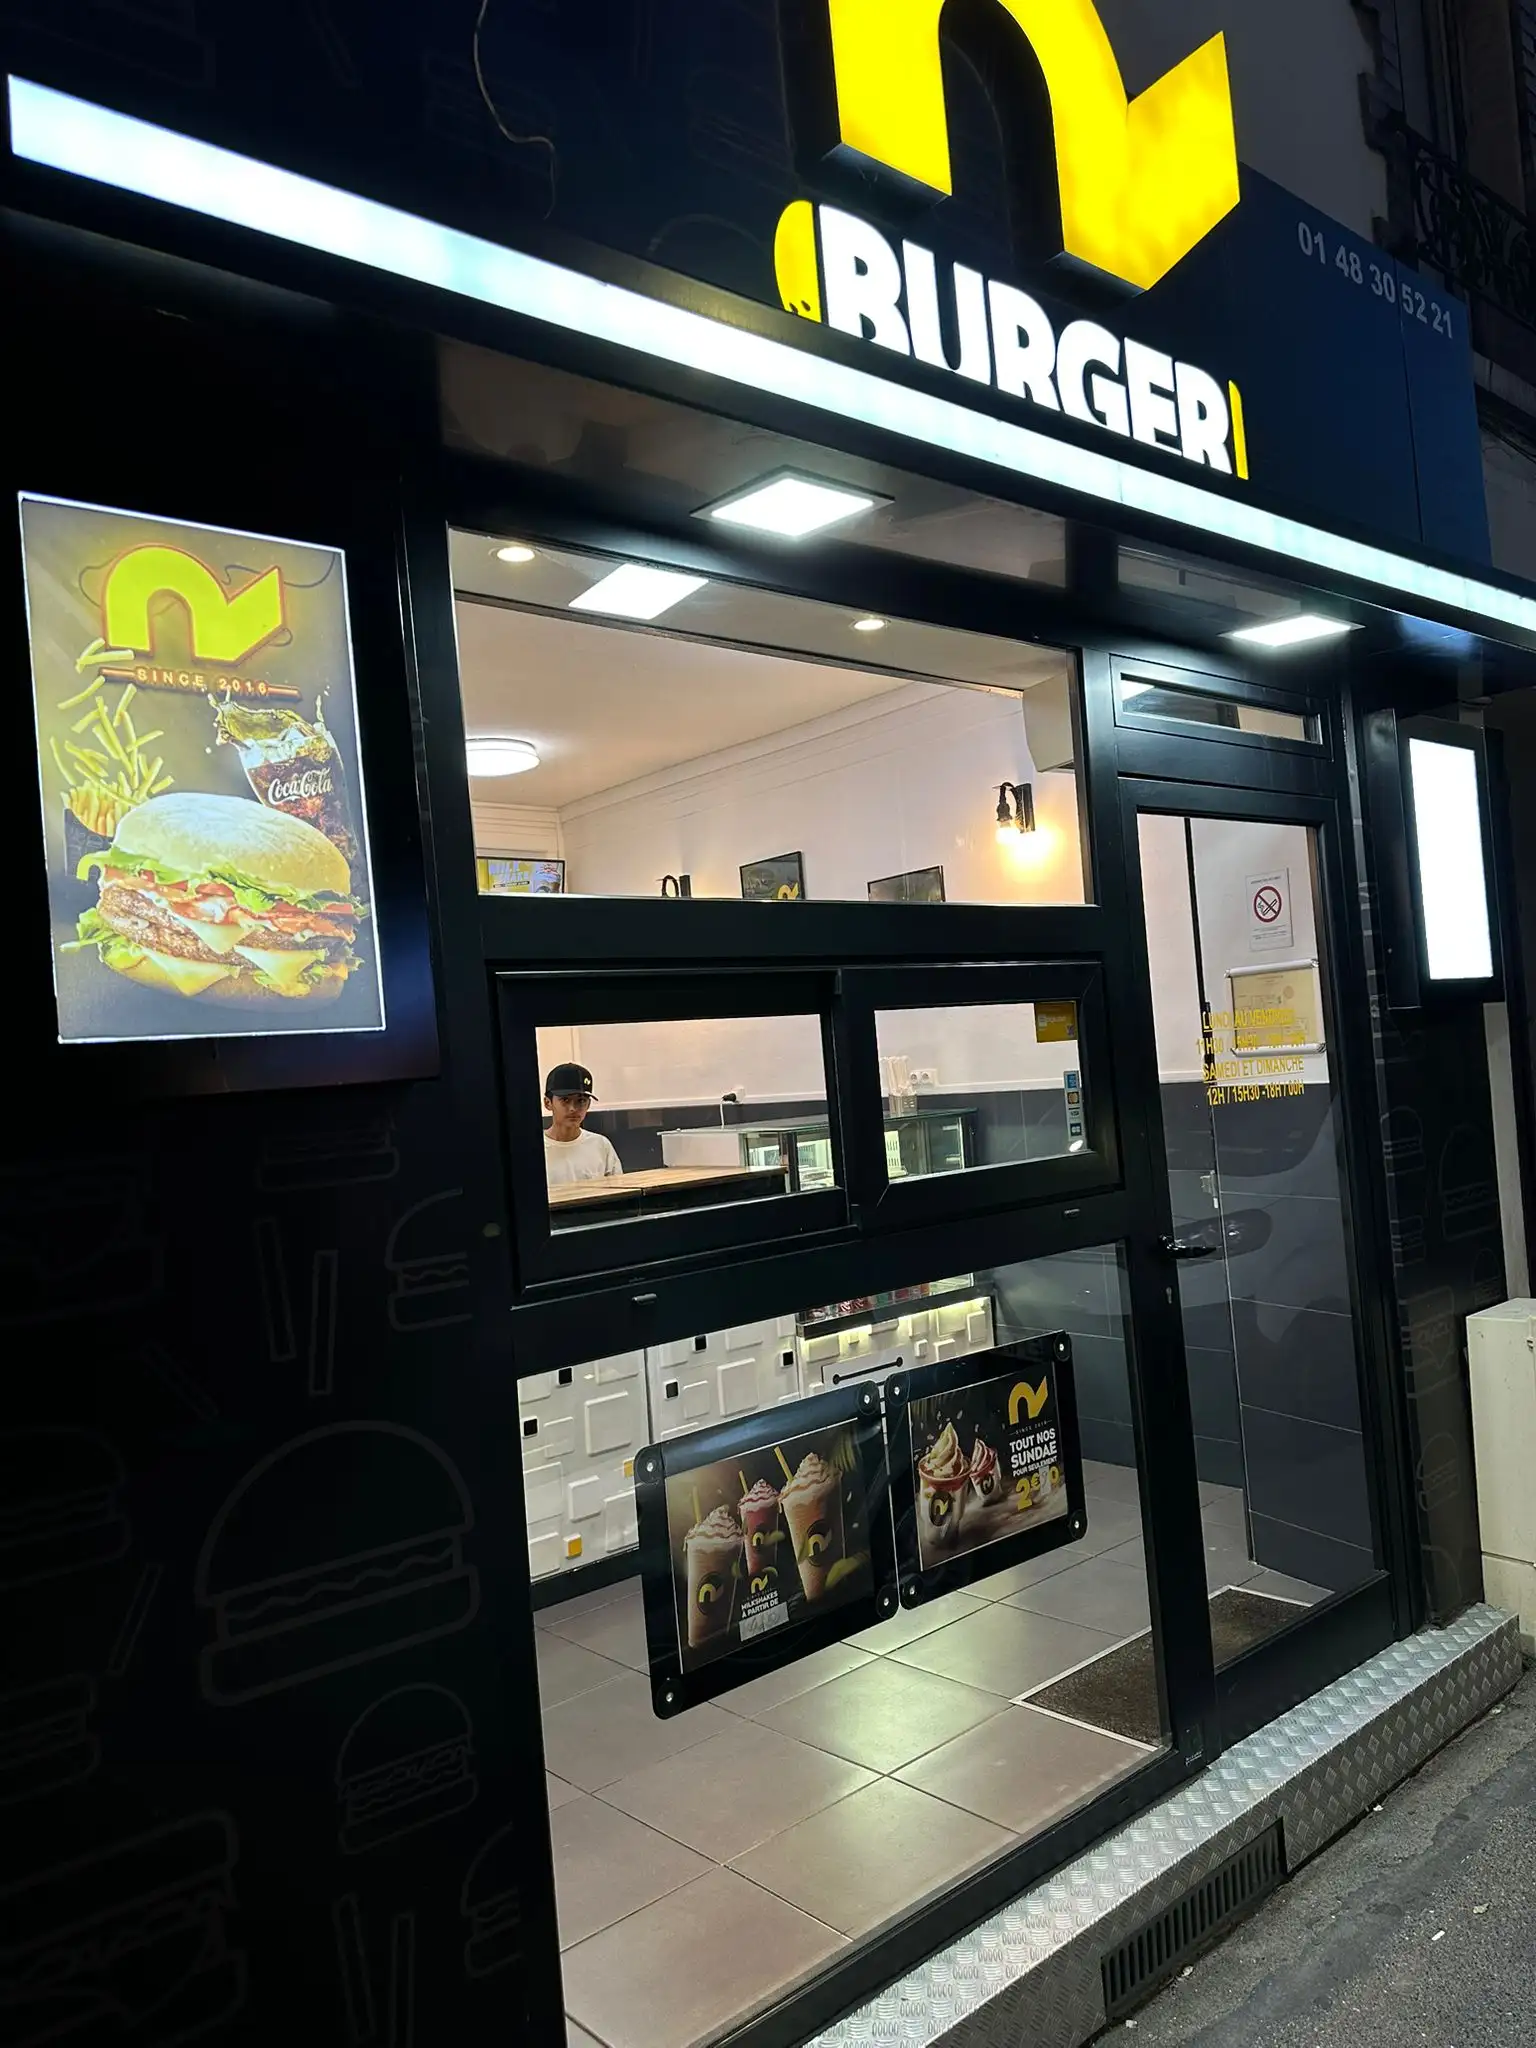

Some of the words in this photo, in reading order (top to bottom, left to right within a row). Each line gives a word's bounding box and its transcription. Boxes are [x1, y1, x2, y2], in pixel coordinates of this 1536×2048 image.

[1297, 221, 1326, 265] 01
[1335, 244, 1363, 285] 48
[1369, 262, 1396, 304] 30
[1401, 282, 1428, 324] 52
[1430, 301, 1453, 339] 21
[818, 203, 1232, 475] BURGER
[137, 668, 204, 687] SINCE
[219, 678, 267, 696] 2016
[1202, 1061, 1241, 1081] SAMEDI
[1243, 1059, 1254, 1076] ET
[1257, 1056, 1304, 1075] DIMANCHE
[1207, 1087, 1225, 1105] 12H
[1232, 1083, 1261, 1103] 15H30
[1009, 1434, 1035, 1453] TOUT
[1036, 1427, 1056, 1445] NOS
[1010, 1440, 1058, 1469] SUNDAE
[1012, 1466, 1028, 1478] POUR
[1027, 1455, 1058, 1472] SEULEMENT
[741, 1590, 779, 1611] MILKSHAKES
[747, 1601, 770, 1617] PARTIR
[769, 1597, 779, 1608] DE
